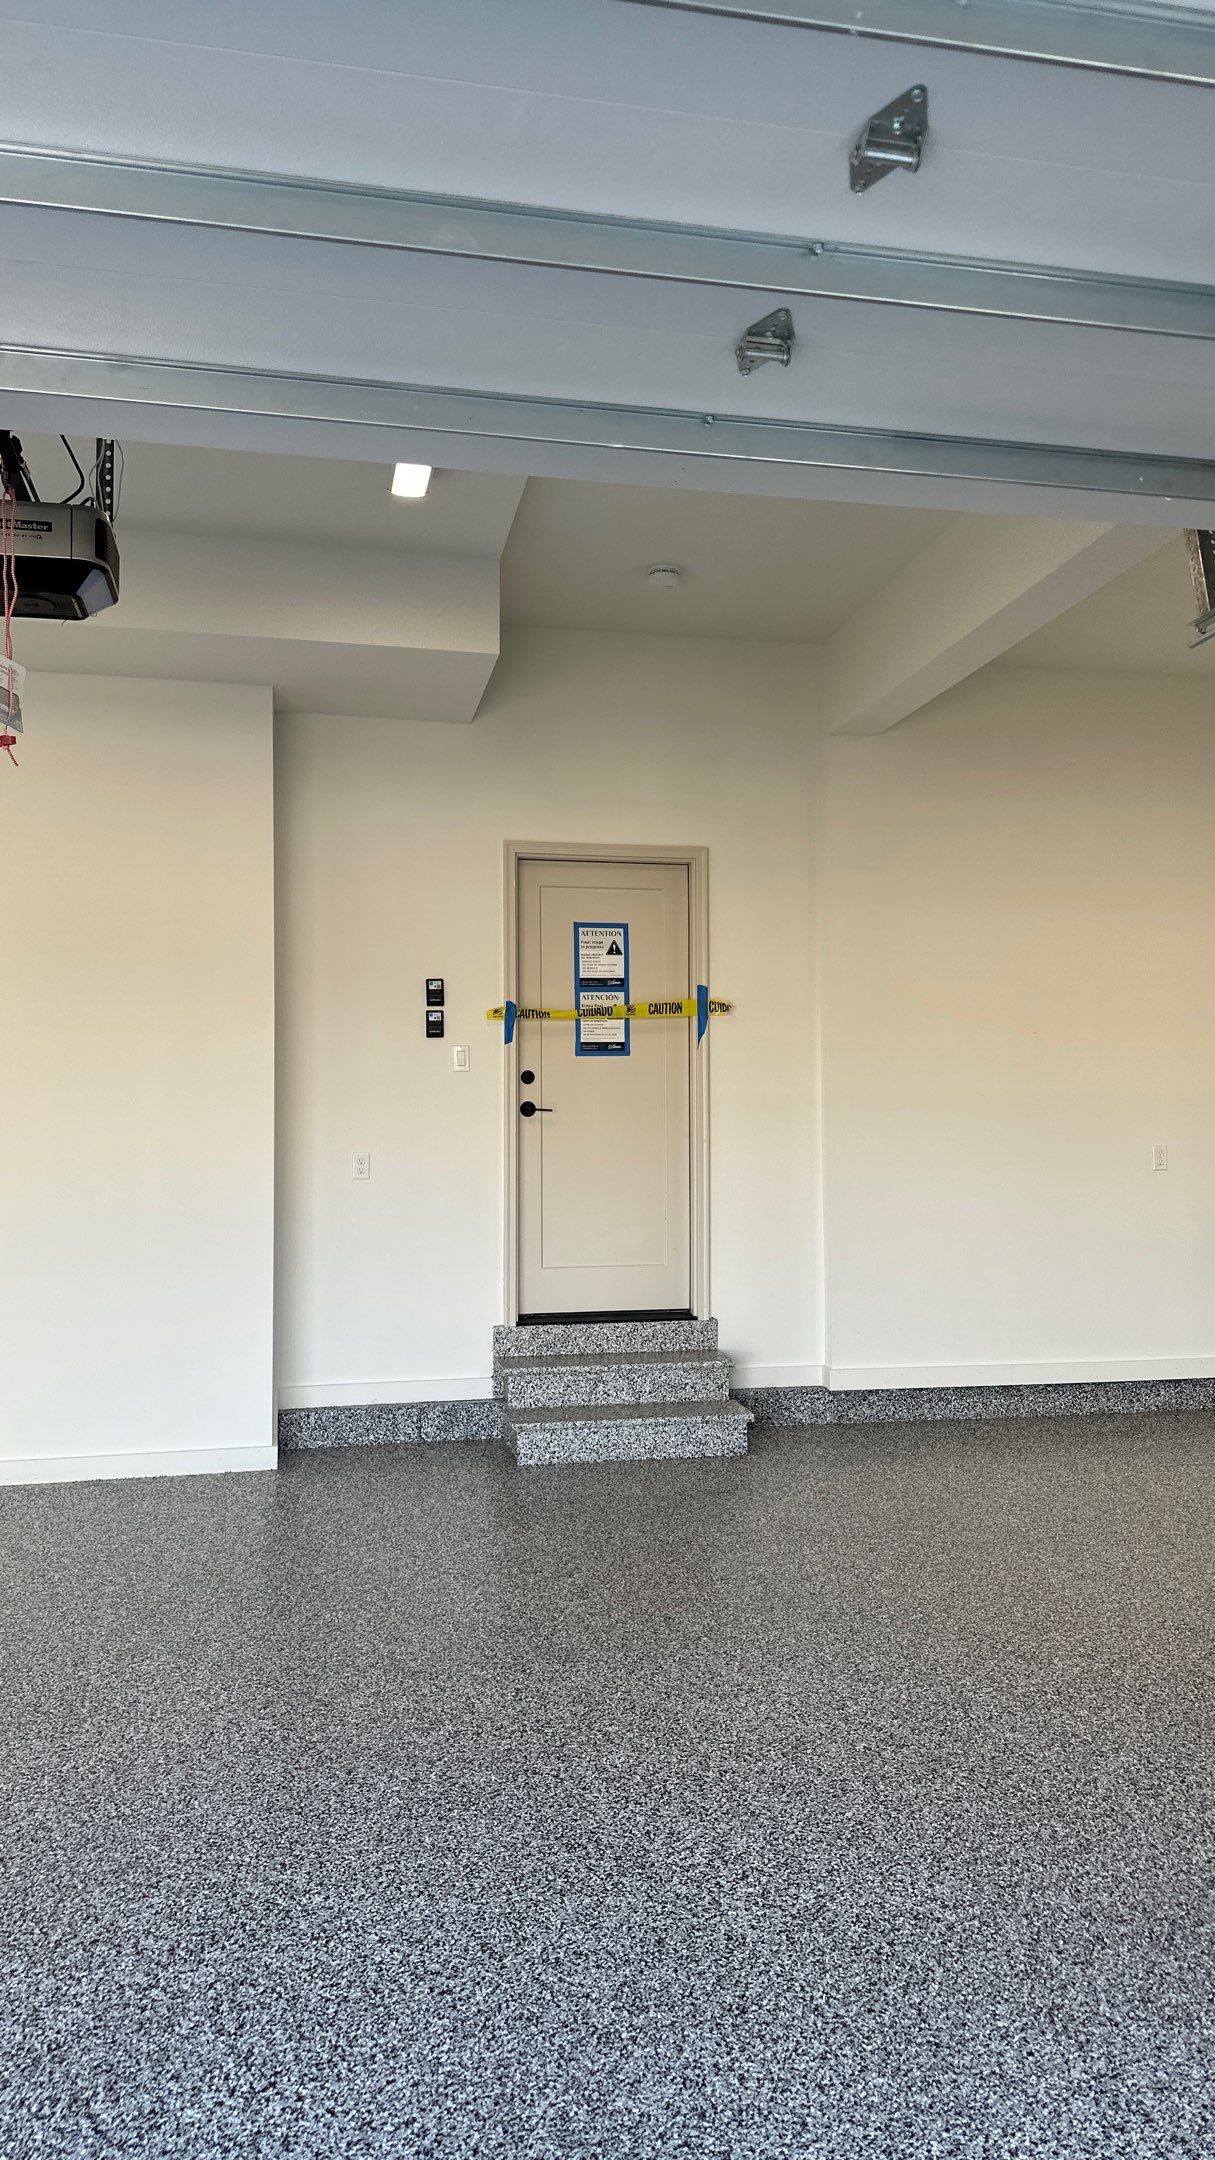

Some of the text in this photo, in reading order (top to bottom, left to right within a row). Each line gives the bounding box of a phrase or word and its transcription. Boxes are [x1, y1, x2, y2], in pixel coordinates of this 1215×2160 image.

[581, 993, 619, 1001] ATENCIÓN
[515, 1008, 550, 1019] CAUTION
[577, 1006, 613, 1017] CUIDADO
[648, 1002, 683, 1015] CAUTION
